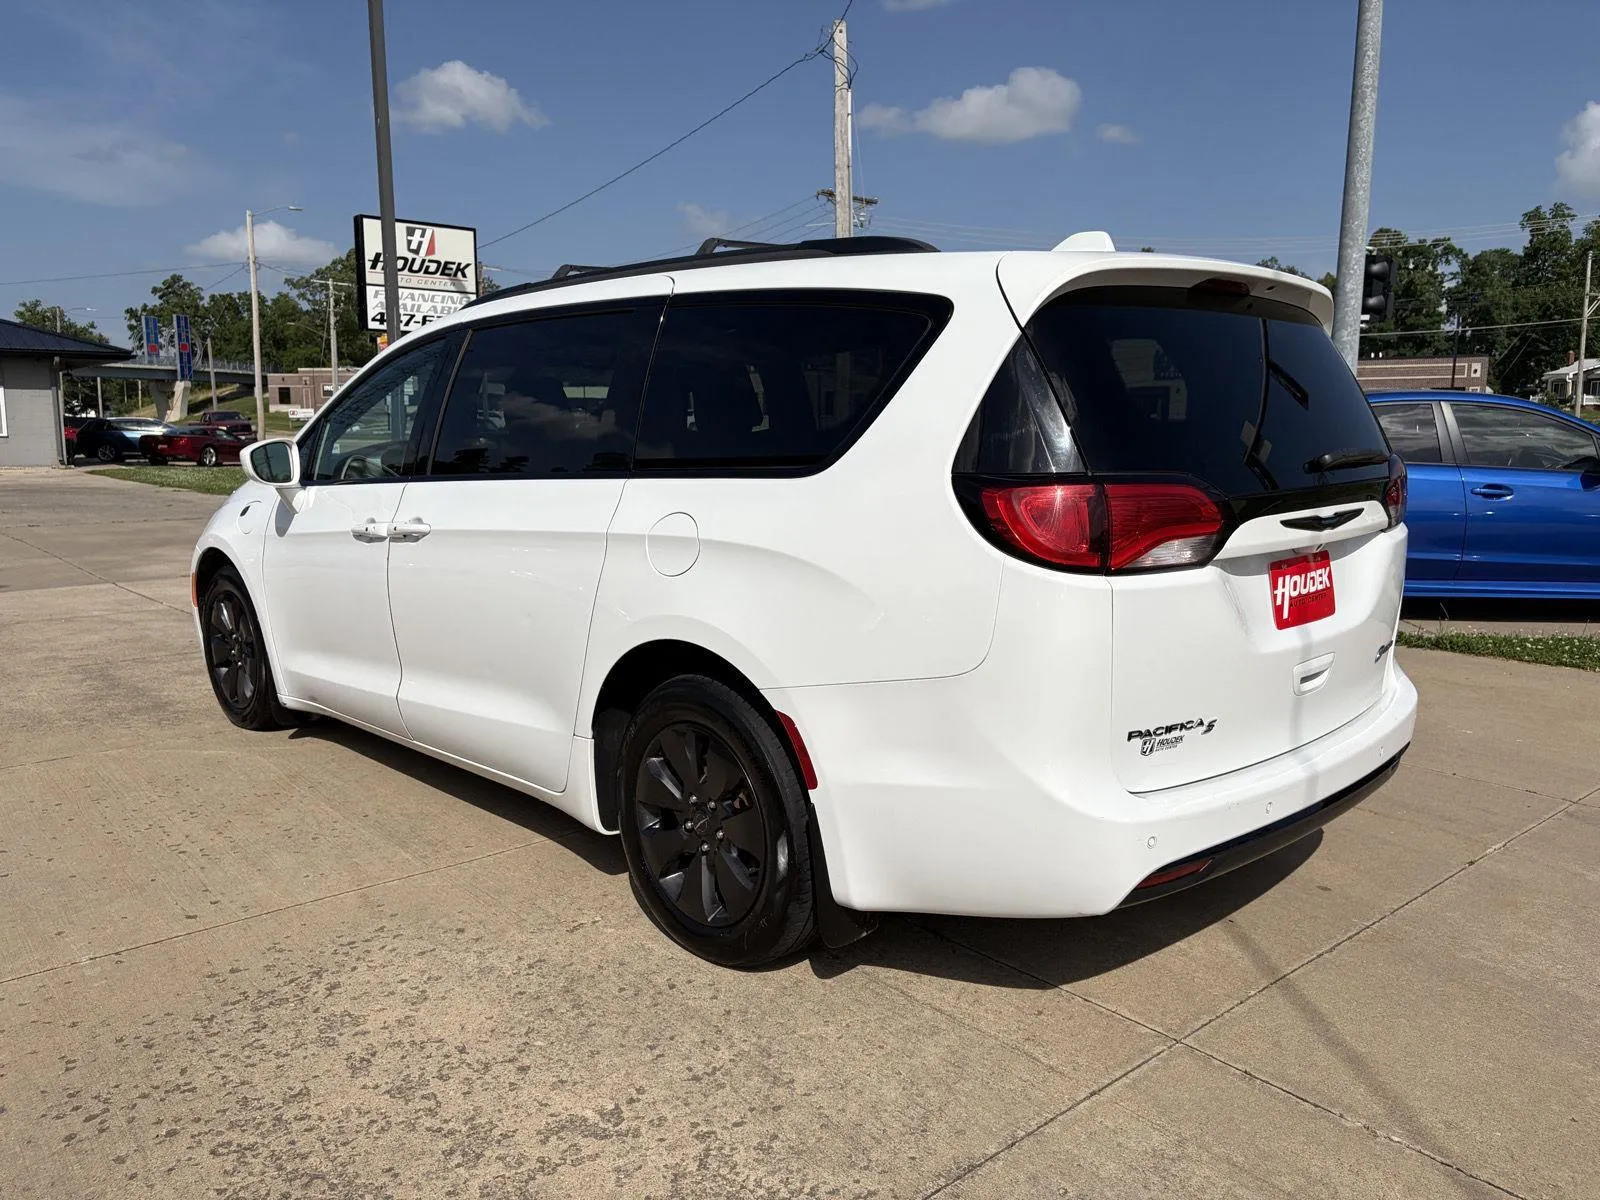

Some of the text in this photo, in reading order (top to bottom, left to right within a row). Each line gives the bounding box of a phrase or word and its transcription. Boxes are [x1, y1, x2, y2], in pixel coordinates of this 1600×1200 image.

[368, 252, 472, 278] HOUDEK
[417, 278, 456, 287] CENTER
[1273, 566, 1331, 620] HOUDEK
[1127, 718, 1218, 742] PACIFICA S
